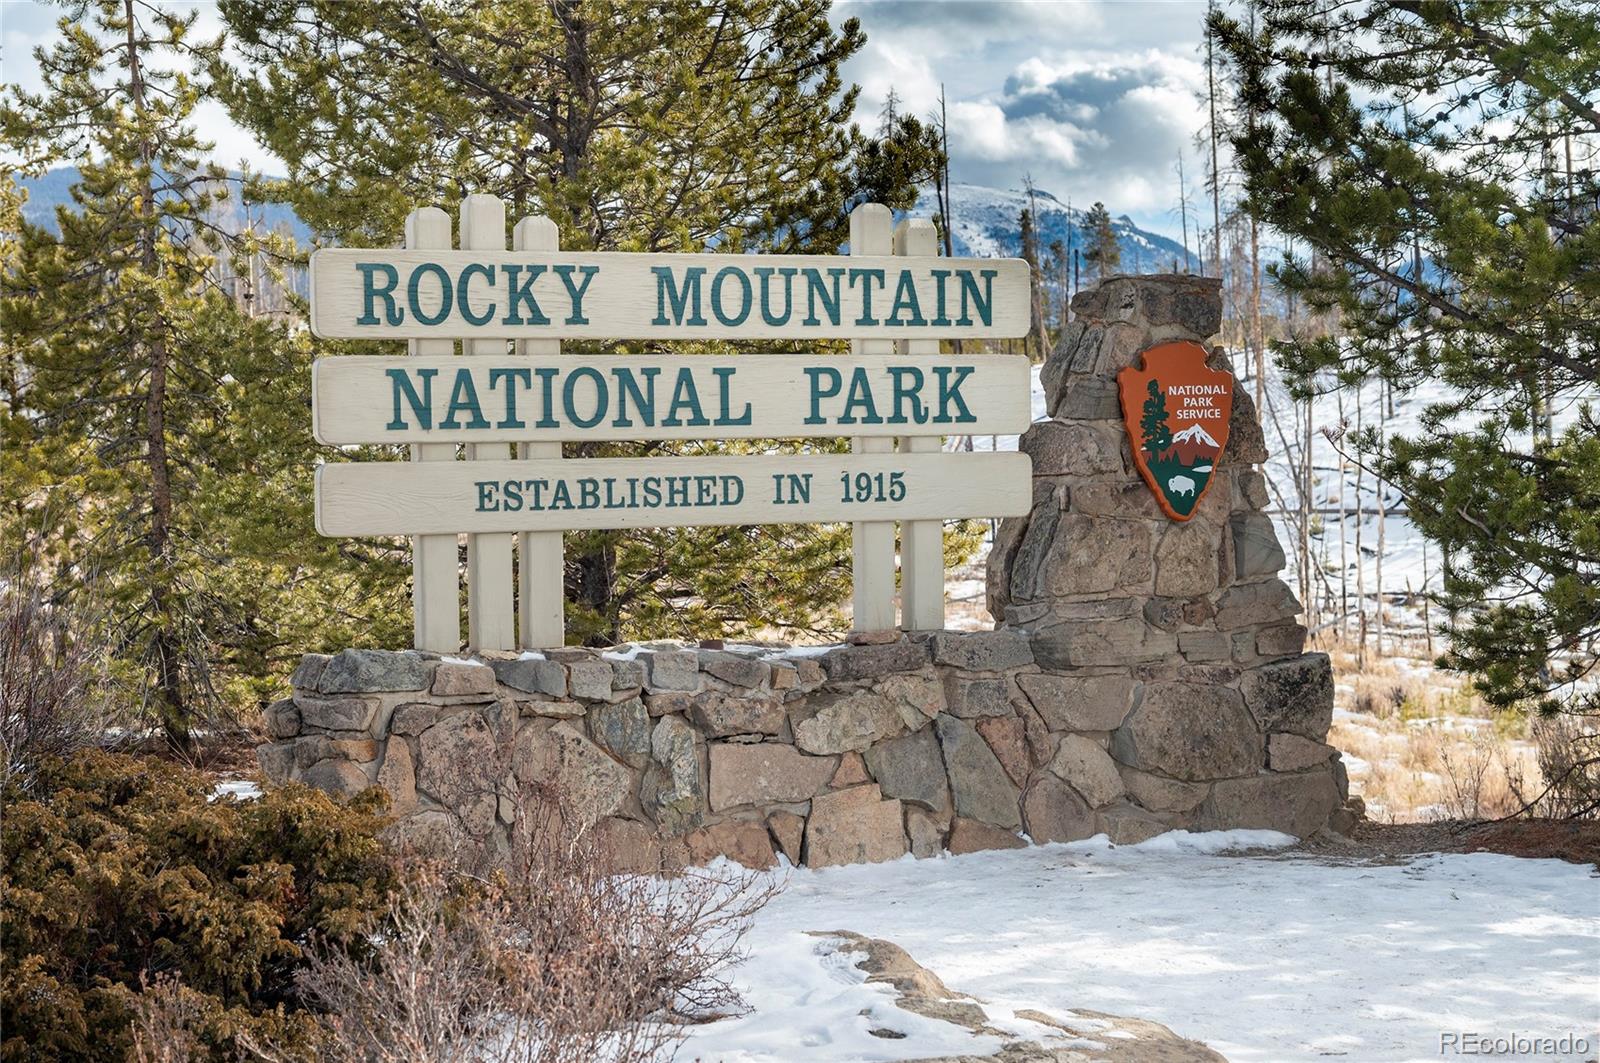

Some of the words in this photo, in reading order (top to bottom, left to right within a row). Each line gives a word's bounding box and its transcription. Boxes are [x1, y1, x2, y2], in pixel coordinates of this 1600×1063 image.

[356, 263, 599, 327] ROCKY
[651, 267, 998, 327] MOUNTAIN
[386, 367, 752, 431] NATIONAL
[804, 367, 977, 424] PARK
[1168, 385, 1227, 396] NATIONAL
[1183, 397, 1213, 407] PARK
[1176, 408, 1221, 420] SERVICE
[474, 475, 744, 512] ESTABLISHED
[773, 474, 814, 505] IN
[841, 471, 907, 503] 1915
